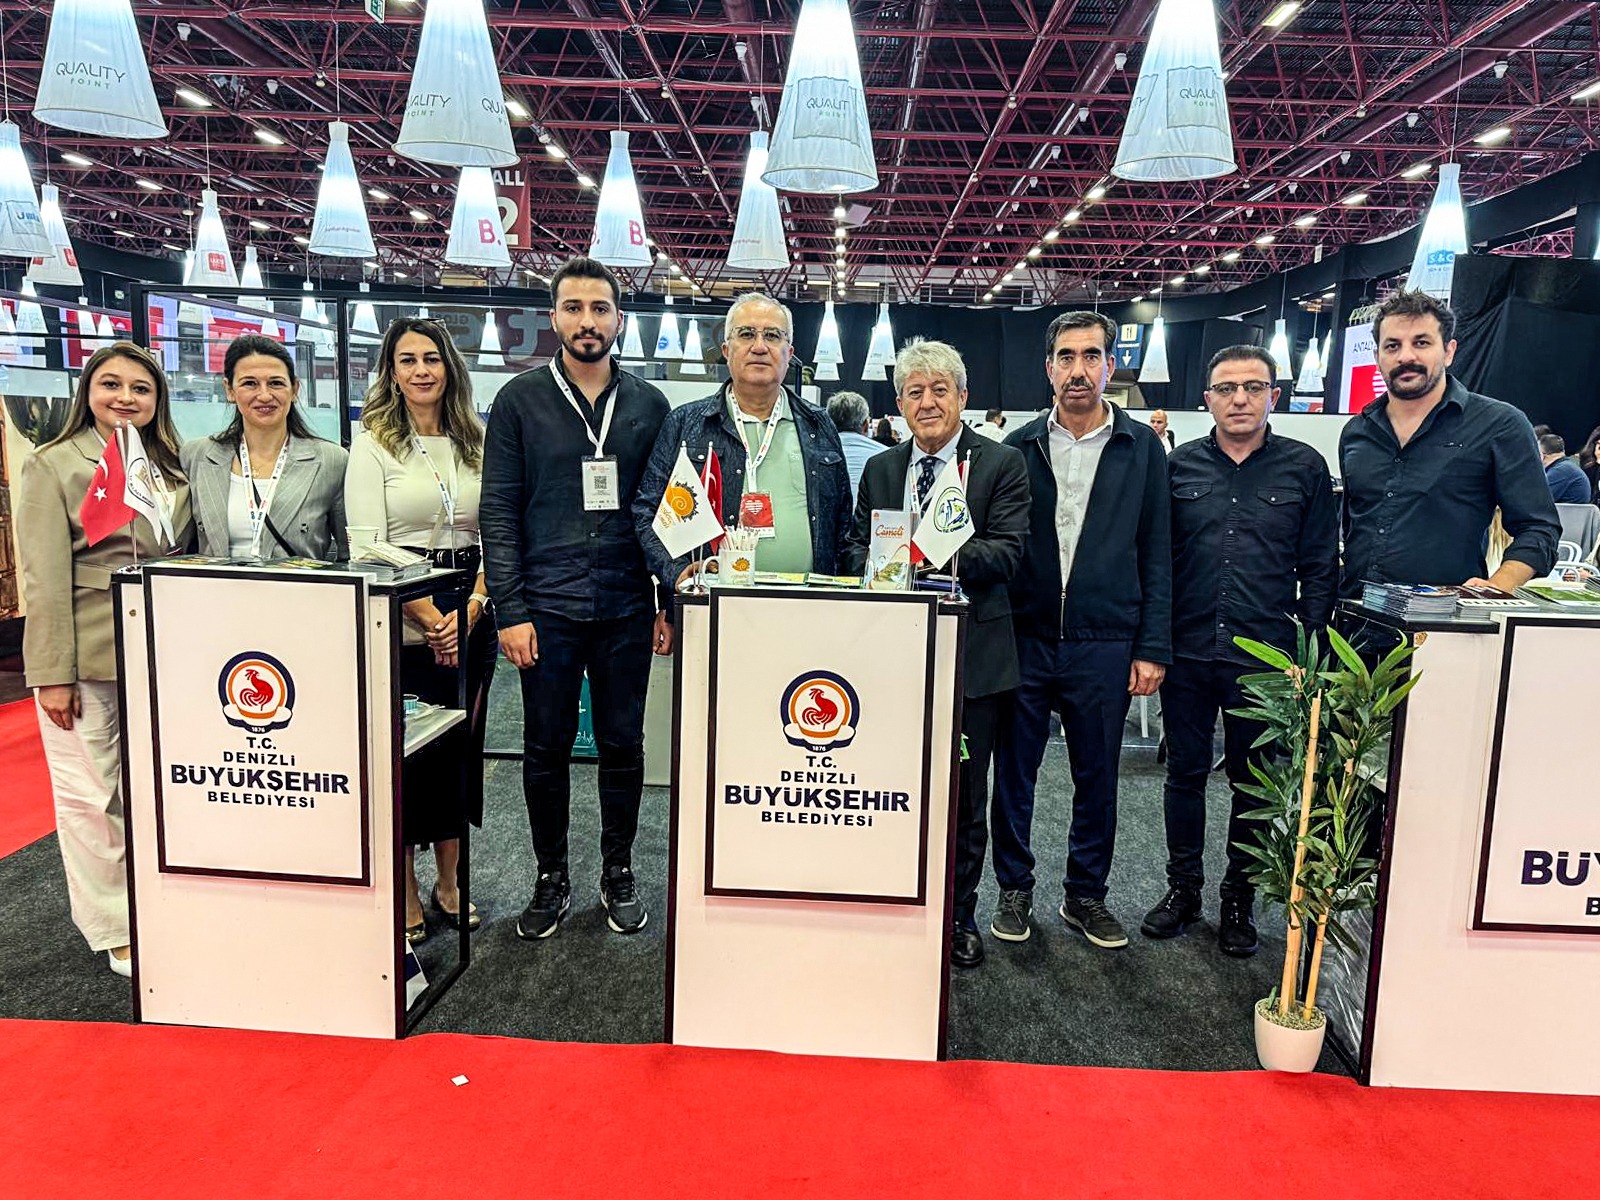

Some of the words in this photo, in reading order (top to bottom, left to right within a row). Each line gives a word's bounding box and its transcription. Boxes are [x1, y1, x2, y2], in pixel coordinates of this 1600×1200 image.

[56, 62, 126, 83] QUALITY
[70, 78, 110, 89] POINT
[806, 97, 849, 111] QUALIT
[494, 170, 525, 186] ALL
[246, 737, 277, 750] T.C.
[223, 751, 295, 766] DENİZLİ
[806, 756, 837, 769] T.C.
[171, 764, 350, 794] BÜYÜKŞEHİR
[781, 771, 856, 785] DENİZLİ
[208, 791, 315, 809] BELEDİYESİ
[725, 785, 910, 812] BÜYÜKŞEHİR
[761, 811, 873, 827] BELEDİYESİ
[1521, 850, 1600, 887] BÜ
